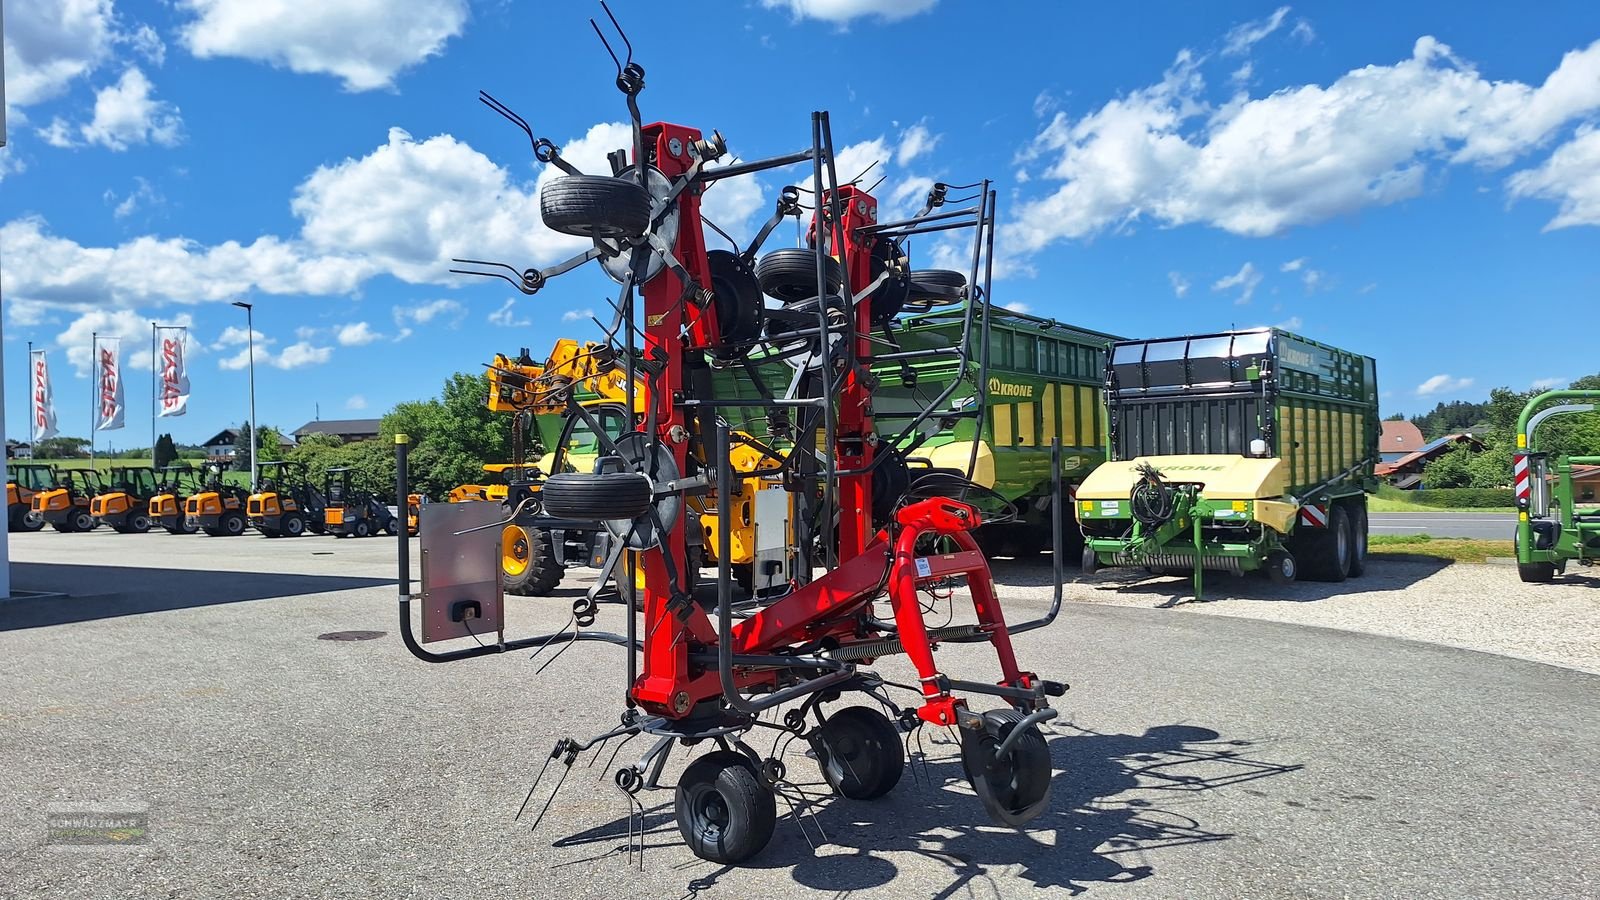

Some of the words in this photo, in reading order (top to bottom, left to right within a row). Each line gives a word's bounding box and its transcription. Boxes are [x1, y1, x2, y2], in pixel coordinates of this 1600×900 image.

[35, 360, 49, 430] STEYR
[101, 348, 118, 417] STEYR
[1000, 382, 1033, 397] KRONE
